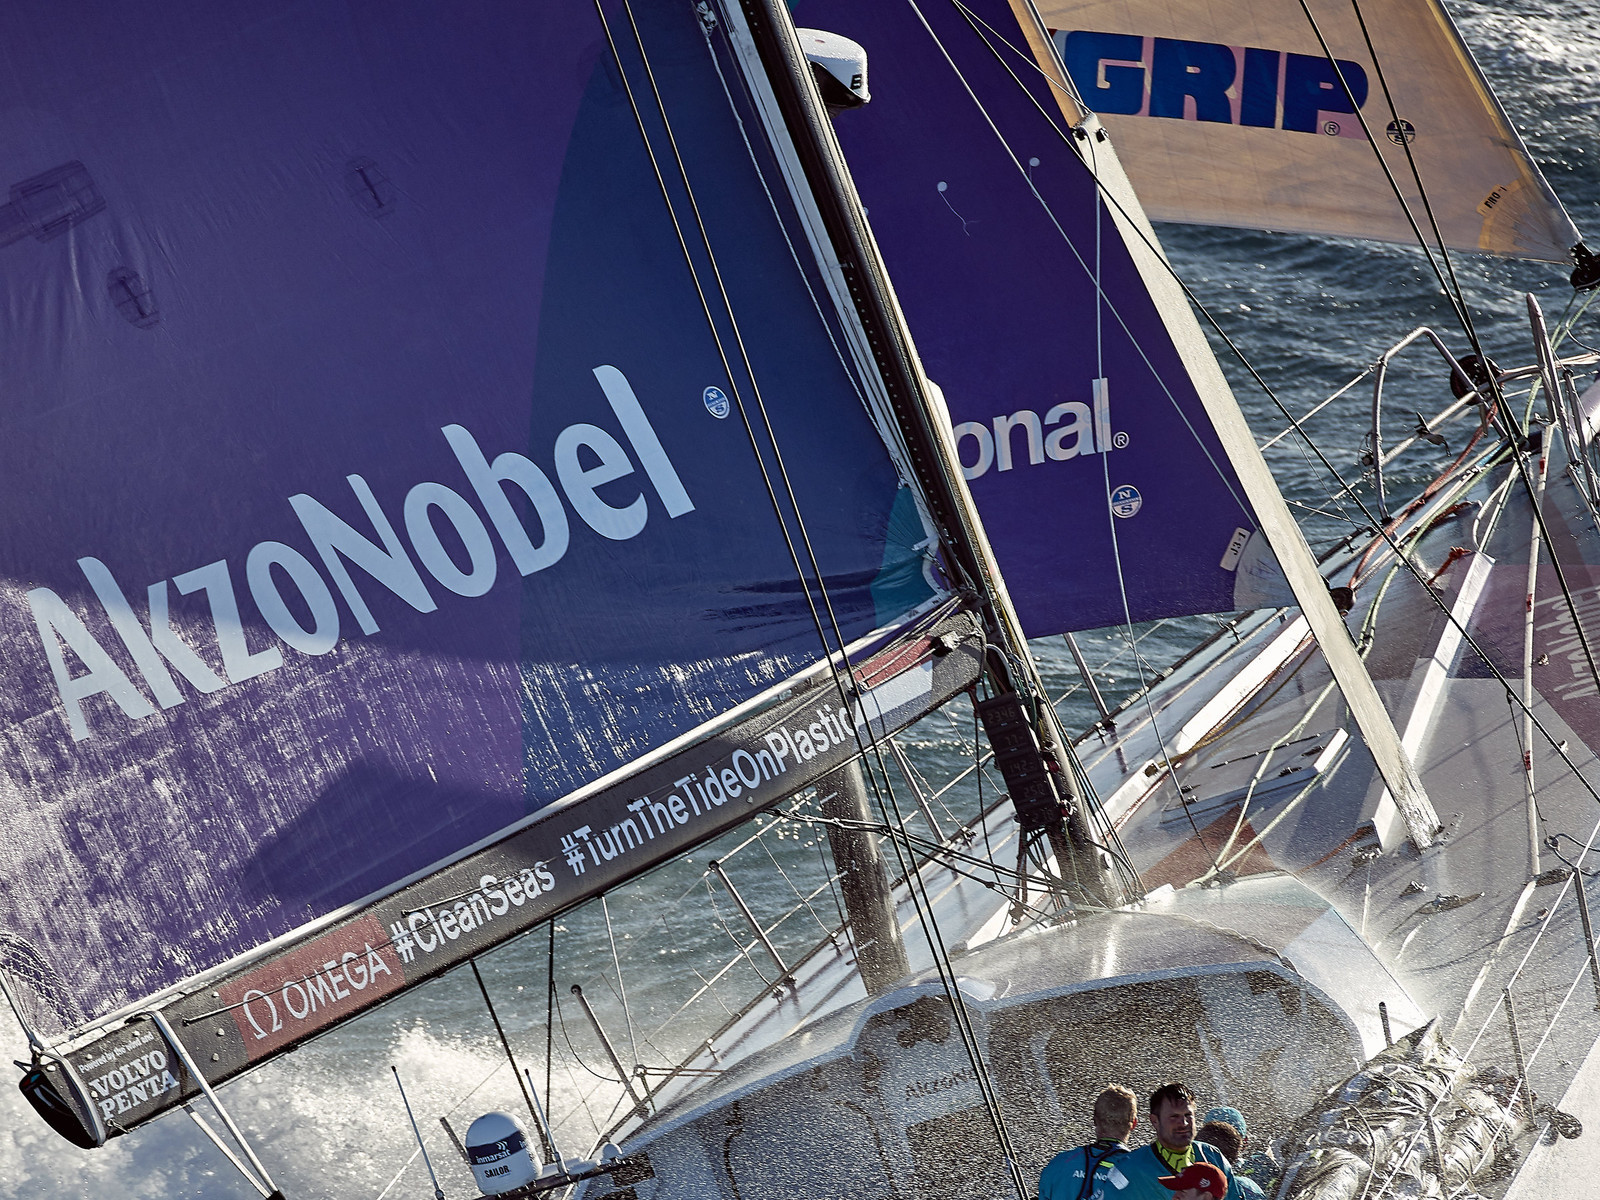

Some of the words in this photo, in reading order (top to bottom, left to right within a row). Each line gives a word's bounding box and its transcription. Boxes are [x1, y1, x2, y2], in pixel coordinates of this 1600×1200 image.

[28, 364, 695, 742] AkzoNobel
[561, 704, 857, 876] #TurnTheTideOnPlastic
[389, 861, 556, 963] #CleanSeas
[282, 943, 392, 1019] OMEGA
[88, 1050, 167, 1098] VOLVO
[98, 1070, 180, 1121] PENTA
[484, 1165, 510, 1178] SAILOR
